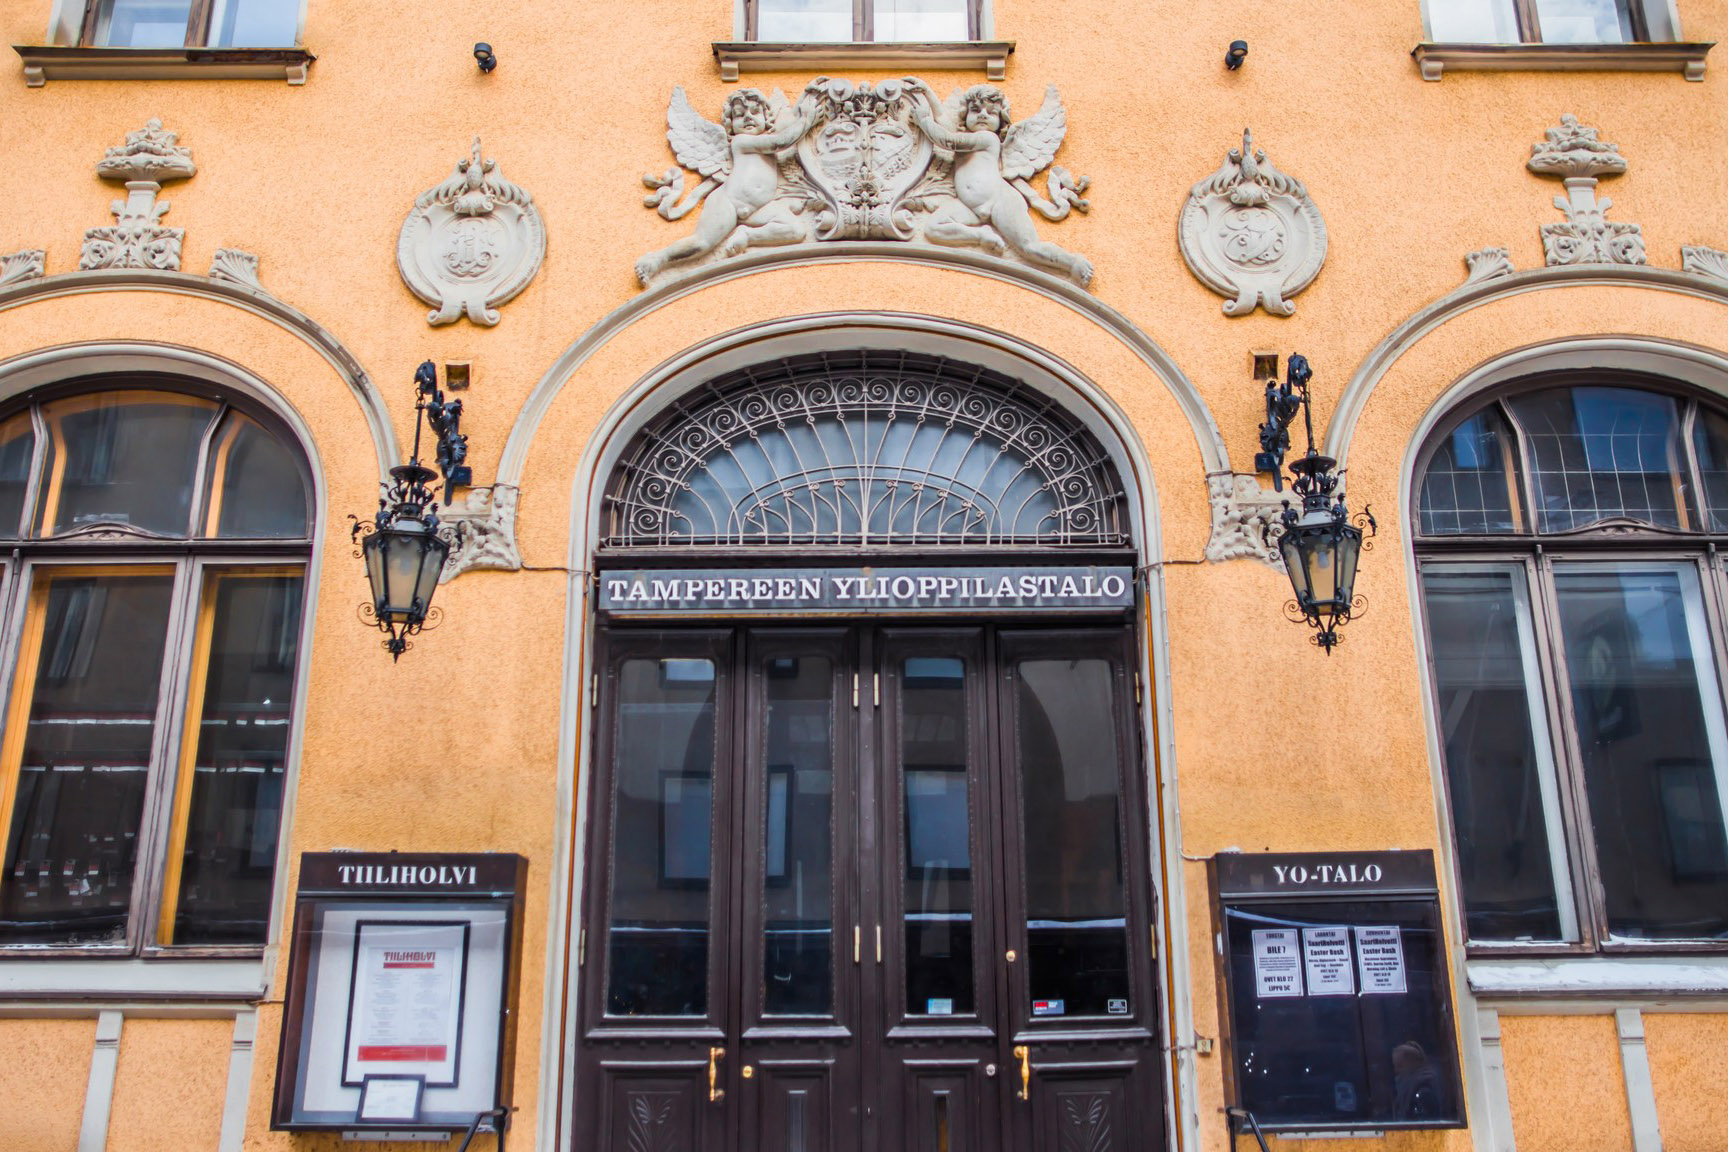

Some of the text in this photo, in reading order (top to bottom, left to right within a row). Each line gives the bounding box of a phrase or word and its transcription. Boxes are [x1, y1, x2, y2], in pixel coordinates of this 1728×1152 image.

[607, 575, 1126, 601] TAMPEREEN YLIOPPILASTALO
[338, 866, 477, 885] TIILIHOLVI
[1273, 864, 1382, 884] YO-TALO
[383, 951, 436, 961] TIILIHOLVI
